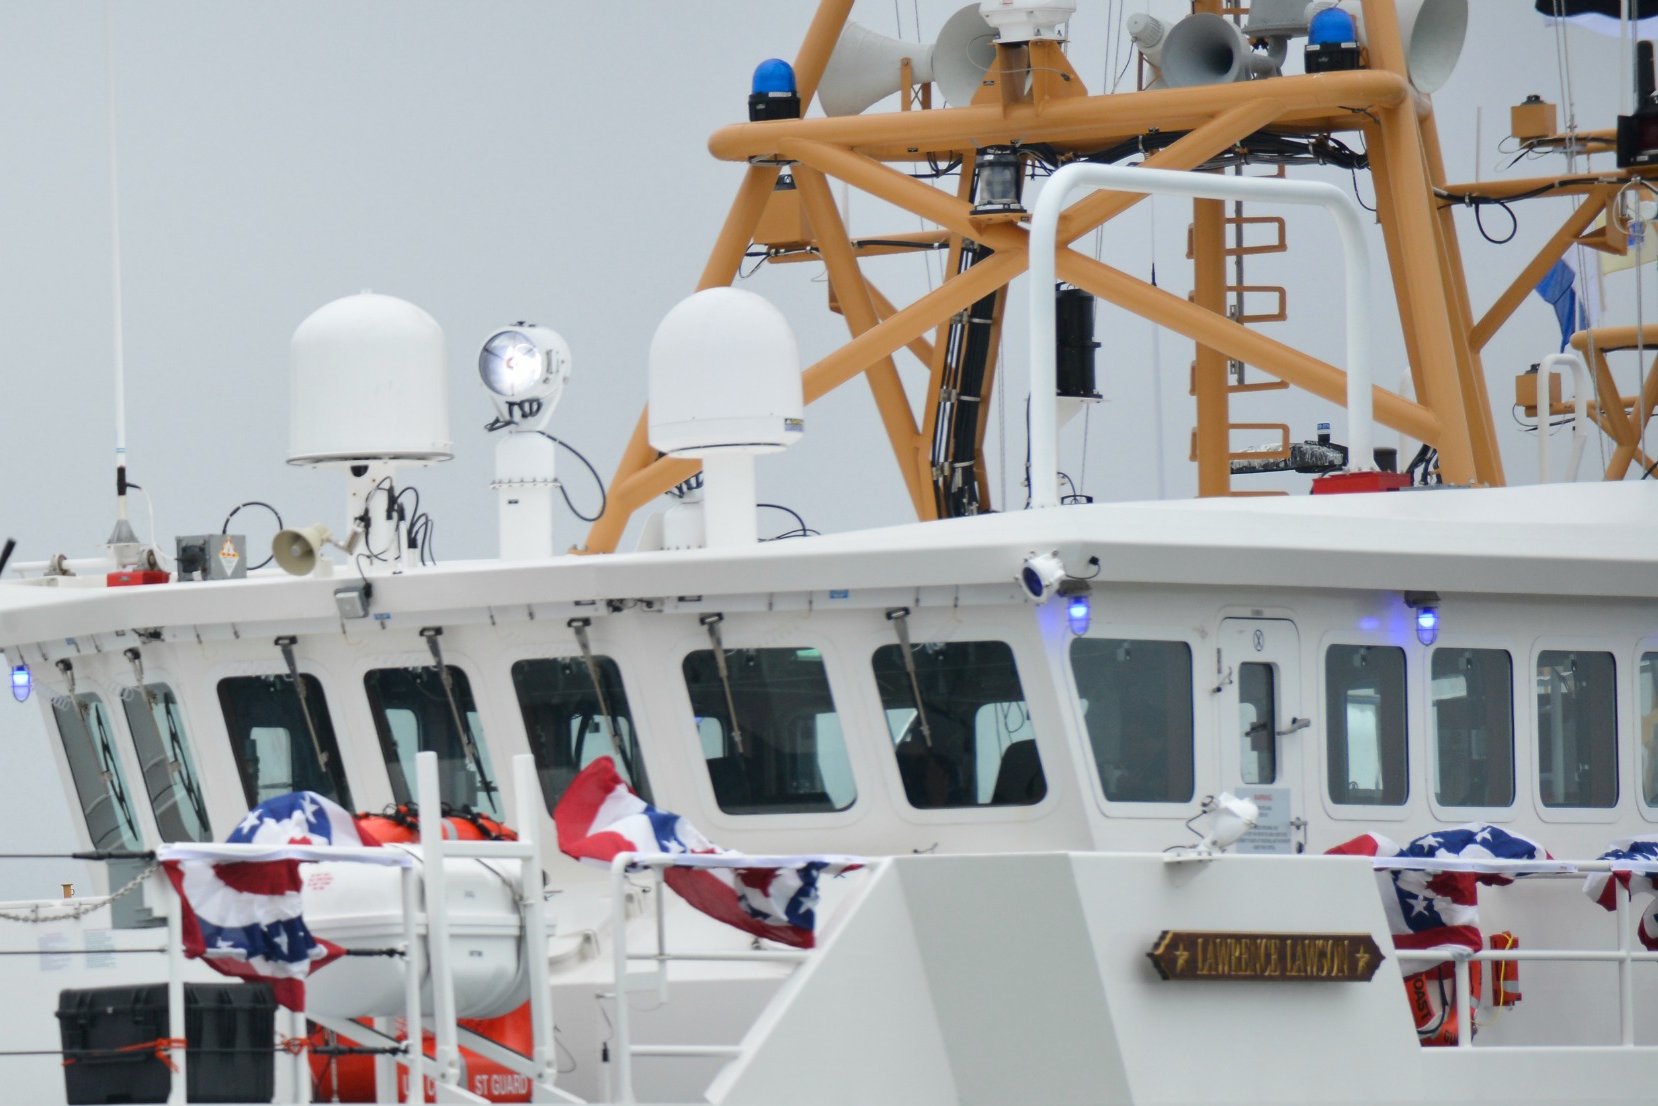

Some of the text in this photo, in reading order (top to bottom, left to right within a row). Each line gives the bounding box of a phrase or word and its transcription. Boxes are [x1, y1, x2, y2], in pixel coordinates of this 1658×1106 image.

[1197, 938, 1349, 977] LAWRENCE LAWSON
[1412, 977, 1433, 1021] OAST
[491, 1074, 529, 1095] GUARD
